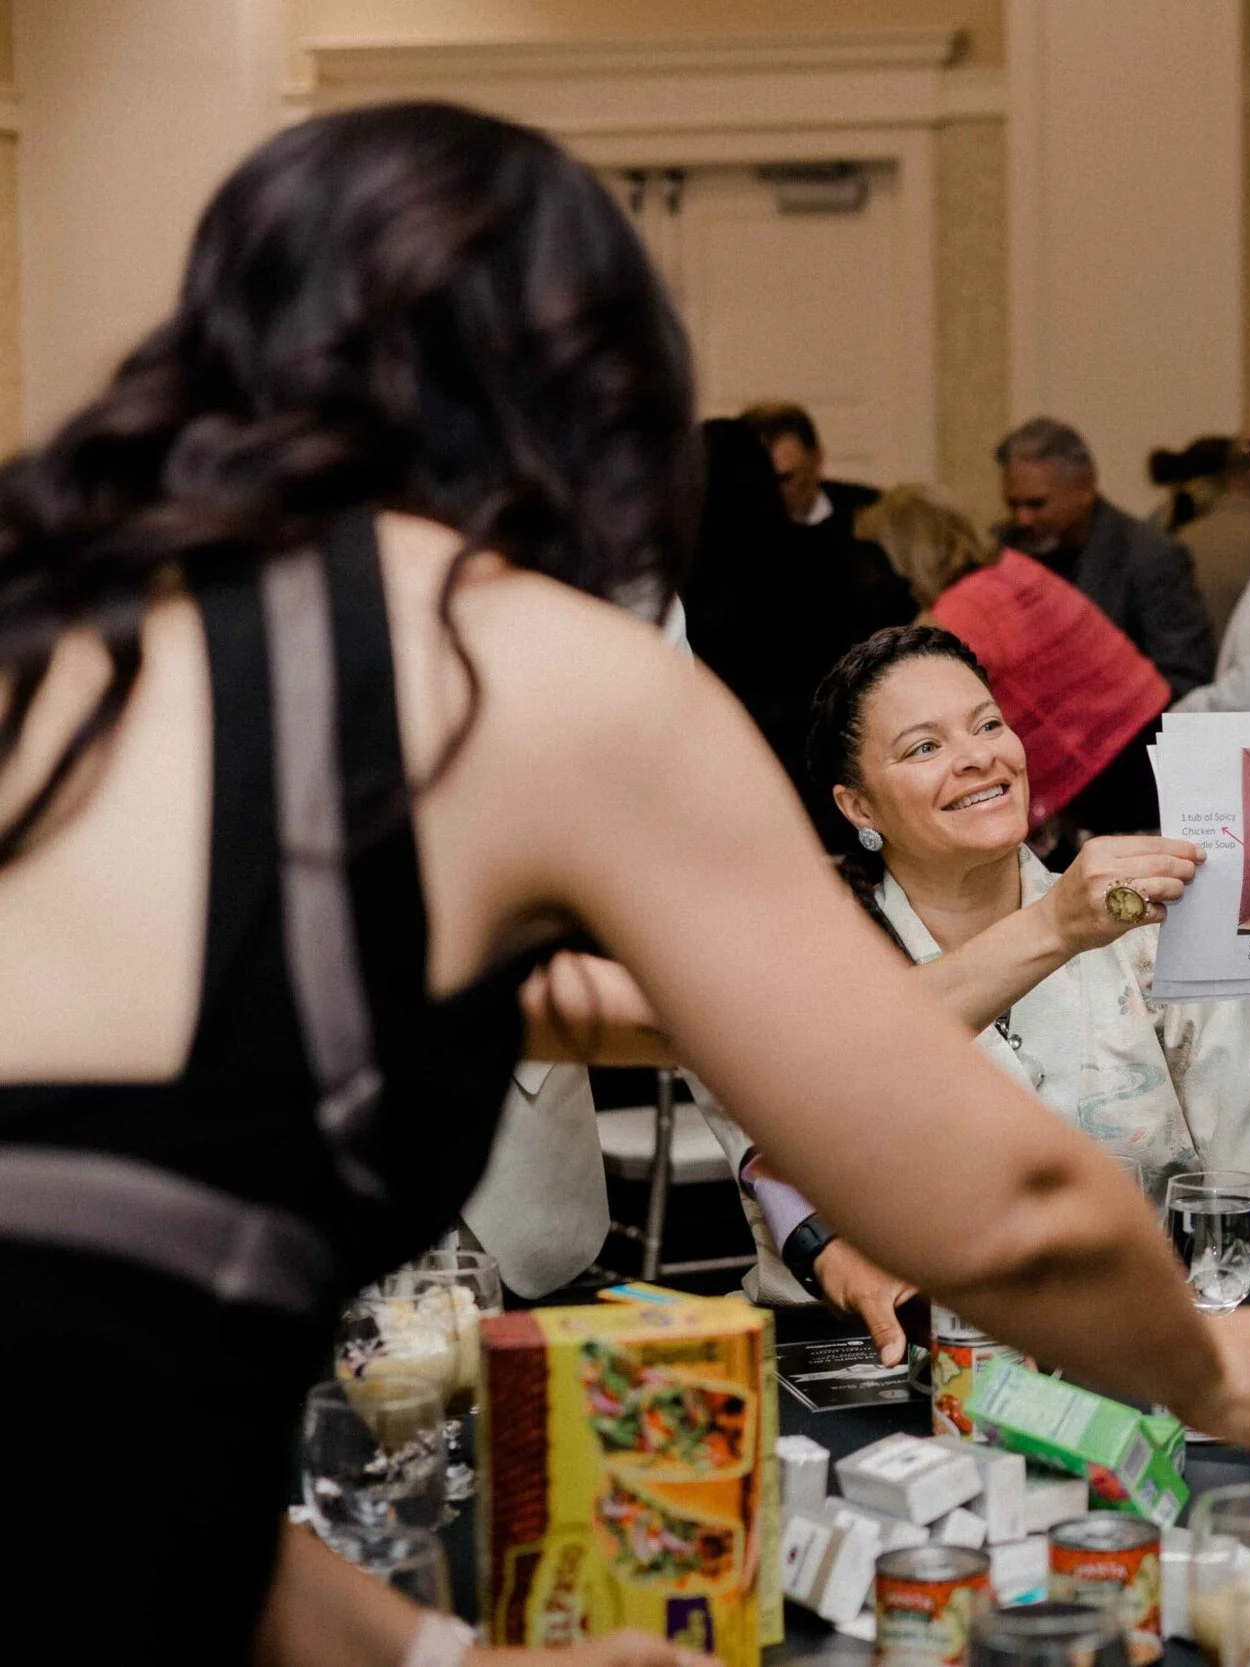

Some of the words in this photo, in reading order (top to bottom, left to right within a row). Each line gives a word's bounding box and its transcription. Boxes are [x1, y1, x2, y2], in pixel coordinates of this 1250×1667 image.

[1188, 813, 1202, 822] tub
[1204, 812, 1213, 821] of
[1214, 812, 1236, 823] Spicy
[1182, 826, 1216, 836] Chicken
[1214, 840, 1236, 850] Soup
